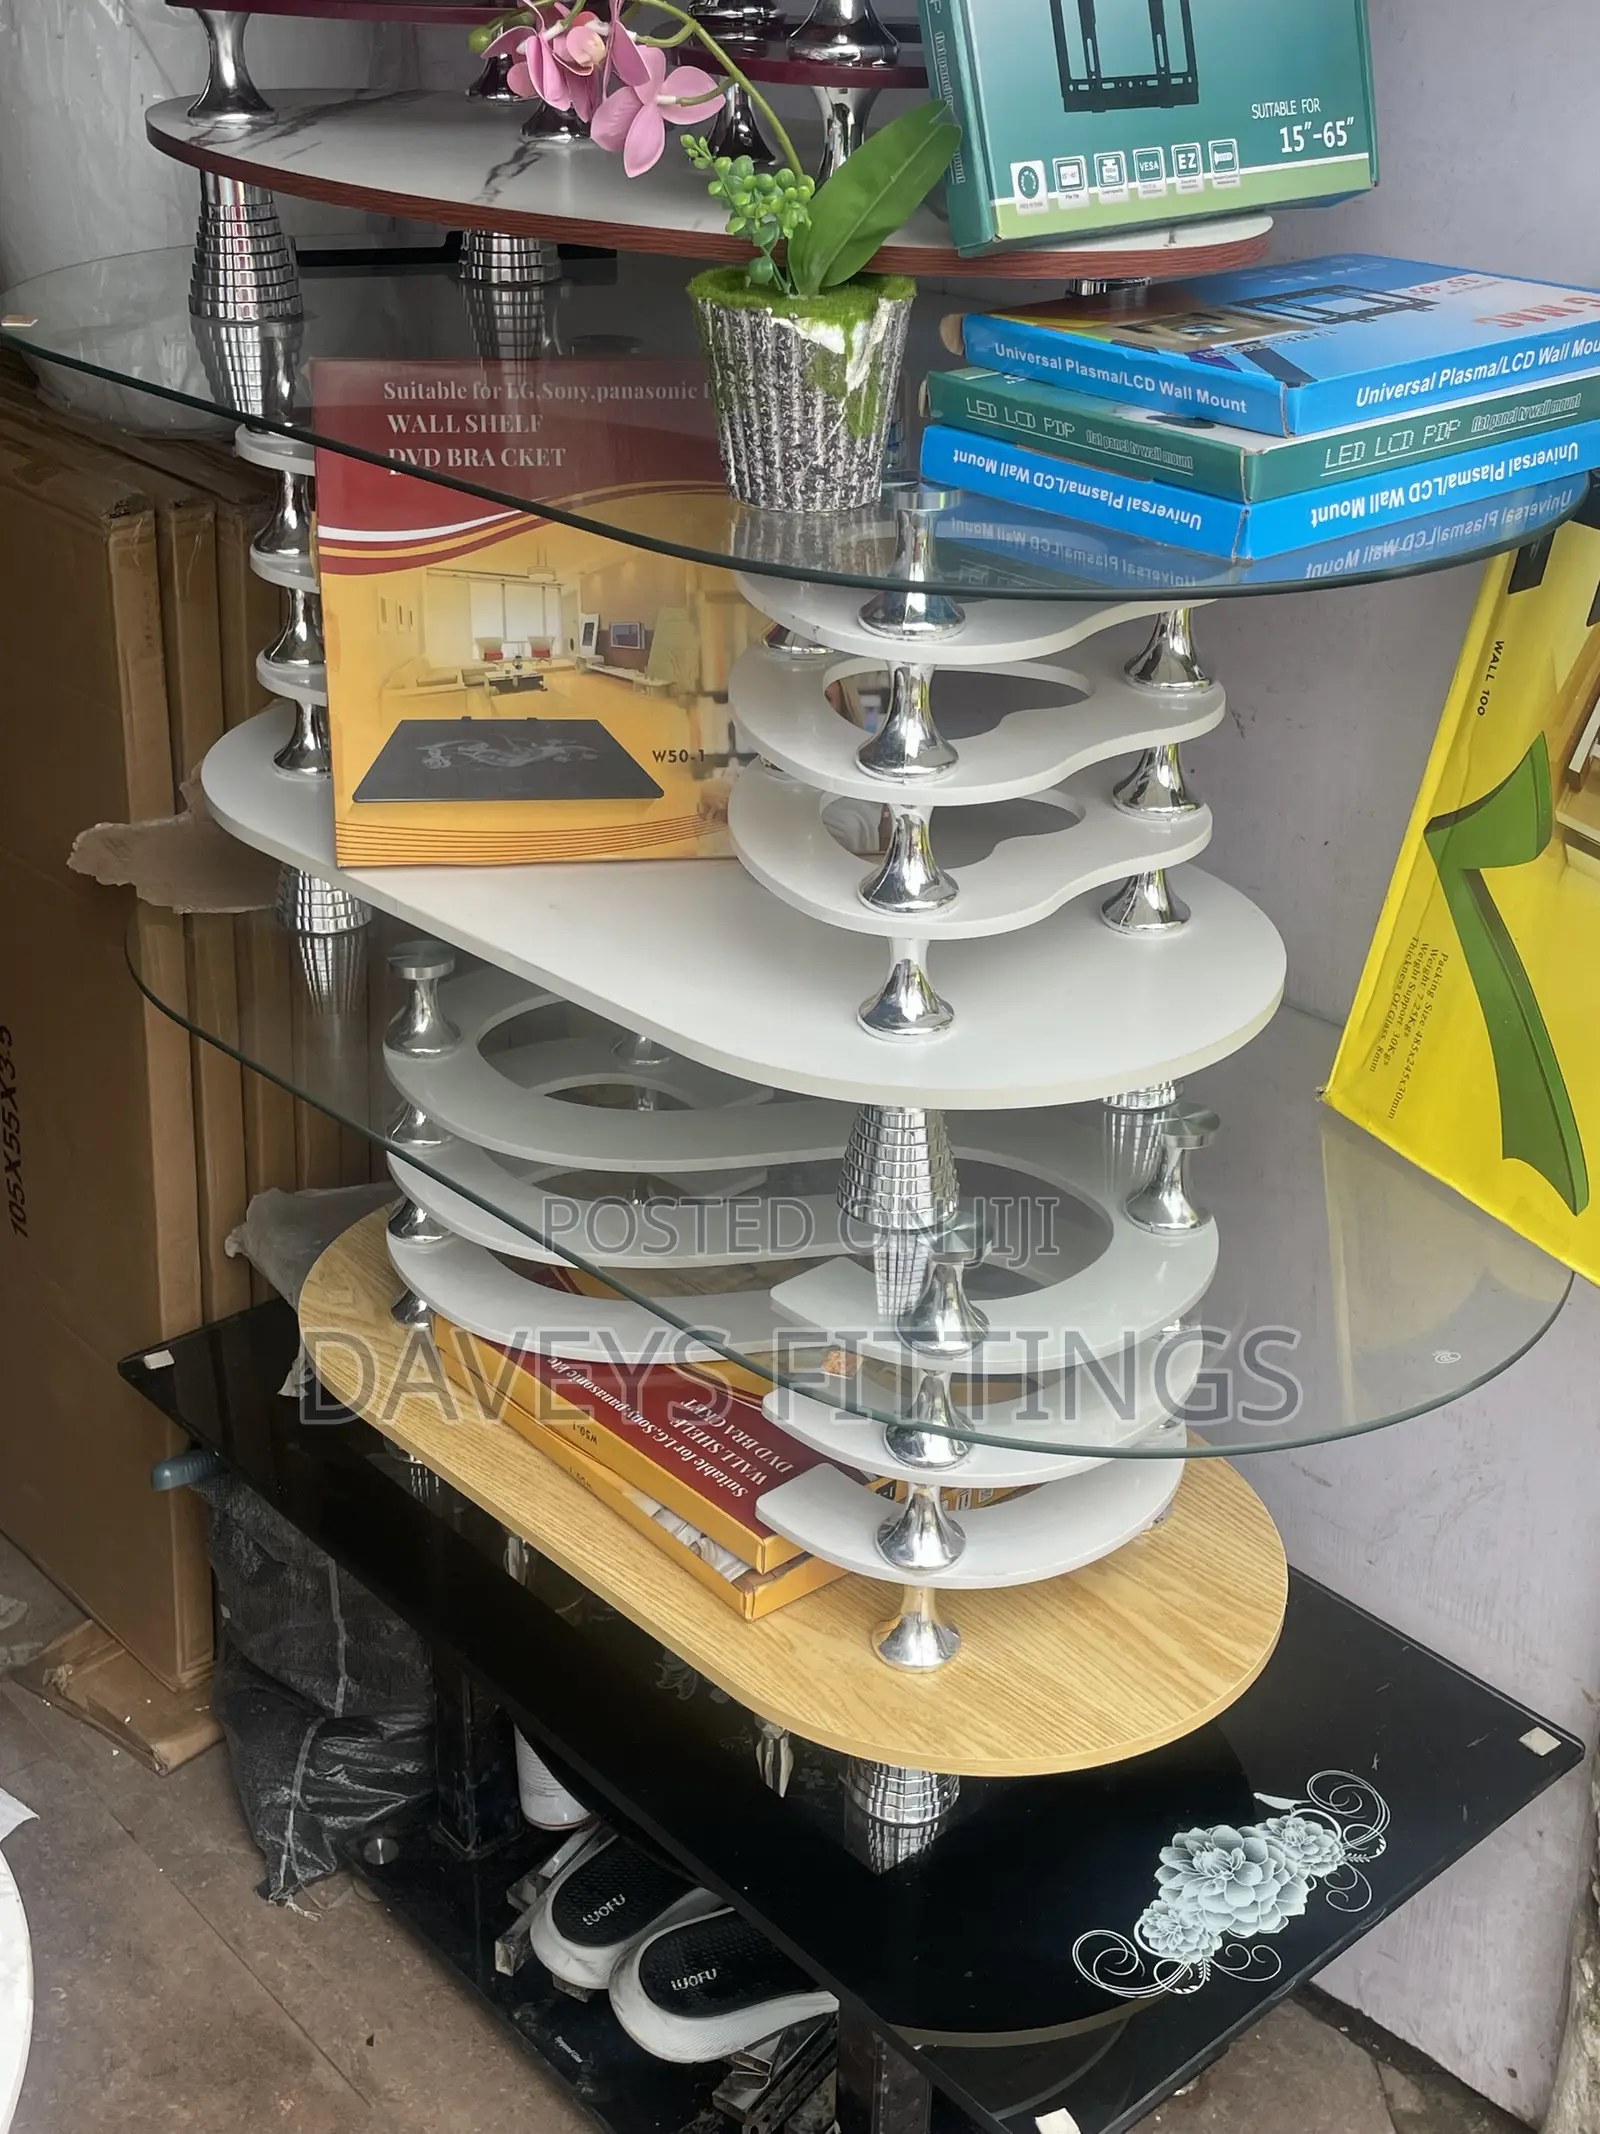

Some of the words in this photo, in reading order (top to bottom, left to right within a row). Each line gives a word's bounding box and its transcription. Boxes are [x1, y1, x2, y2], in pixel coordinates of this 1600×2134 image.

[1251, 100, 1298, 119] SUITABLE
[1302, 97, 1321, 114] FOR
[1138, 160, 1159, 172] VESA
[1177, 153, 1197, 170] EZ
[995, 342, 1062, 370] Universal
[1065, 359, 1156, 392] Plasma/LCD
[1159, 381, 1192, 401] Wall
[1196, 388, 1247, 413] Mount
[1356, 372, 1437, 407] Universal
[1438, 350, 1534, 389] Plasma/LCD
[1538, 341, 1570, 365] Wall
[1571, 337, 1600, 358] Mou
[383, 380, 468, 400] Suitable
[473, 380, 502, 400] for
[387, 414, 460, 434] WALL
[465, 413, 545, 434] SHELF
[966, 397, 998, 418] LED
[1004, 407, 1036, 429] LCD
[1044, 417, 1075, 438] PDP
[1325, 441, 1365, 469] LED
[1374, 429, 1415, 457] LCD
[1422, 418, 1460, 445] PDP
[388, 447, 441, 475] DVD
[953, 449, 997, 474] Mount
[1000, 461, 1030, 483] Wall
[1507, 442, 1579, 478] Universal
[1032, 471, 1124, 509] Plasma/LCD
[1408, 460, 1506, 503] Plasma/LCD
[1310, 497, 1366, 528] Mount
[1369, 486, 1405, 513] Wall
[1127, 500, 1201, 530] Universal
[1485, 640, 1505, 682] WALL
[1477, 689, 1490, 716] 100
[652, 748, 705, 763] W50-1
[1395, 936, 1419, 992] Thickness
[1412, 942, 1430, 980] Weight
[1426, 951, 1449, 999] Packing
[572, 1420, 598, 1446] W50-1
[669, 1418, 725, 1454] SHELF
[676, 1444, 698, 1463] for
[721, 1449, 768, 1486] WALL
[754, 1448, 793, 1474] DVD
[694, 1456, 749, 1498] Suitable
